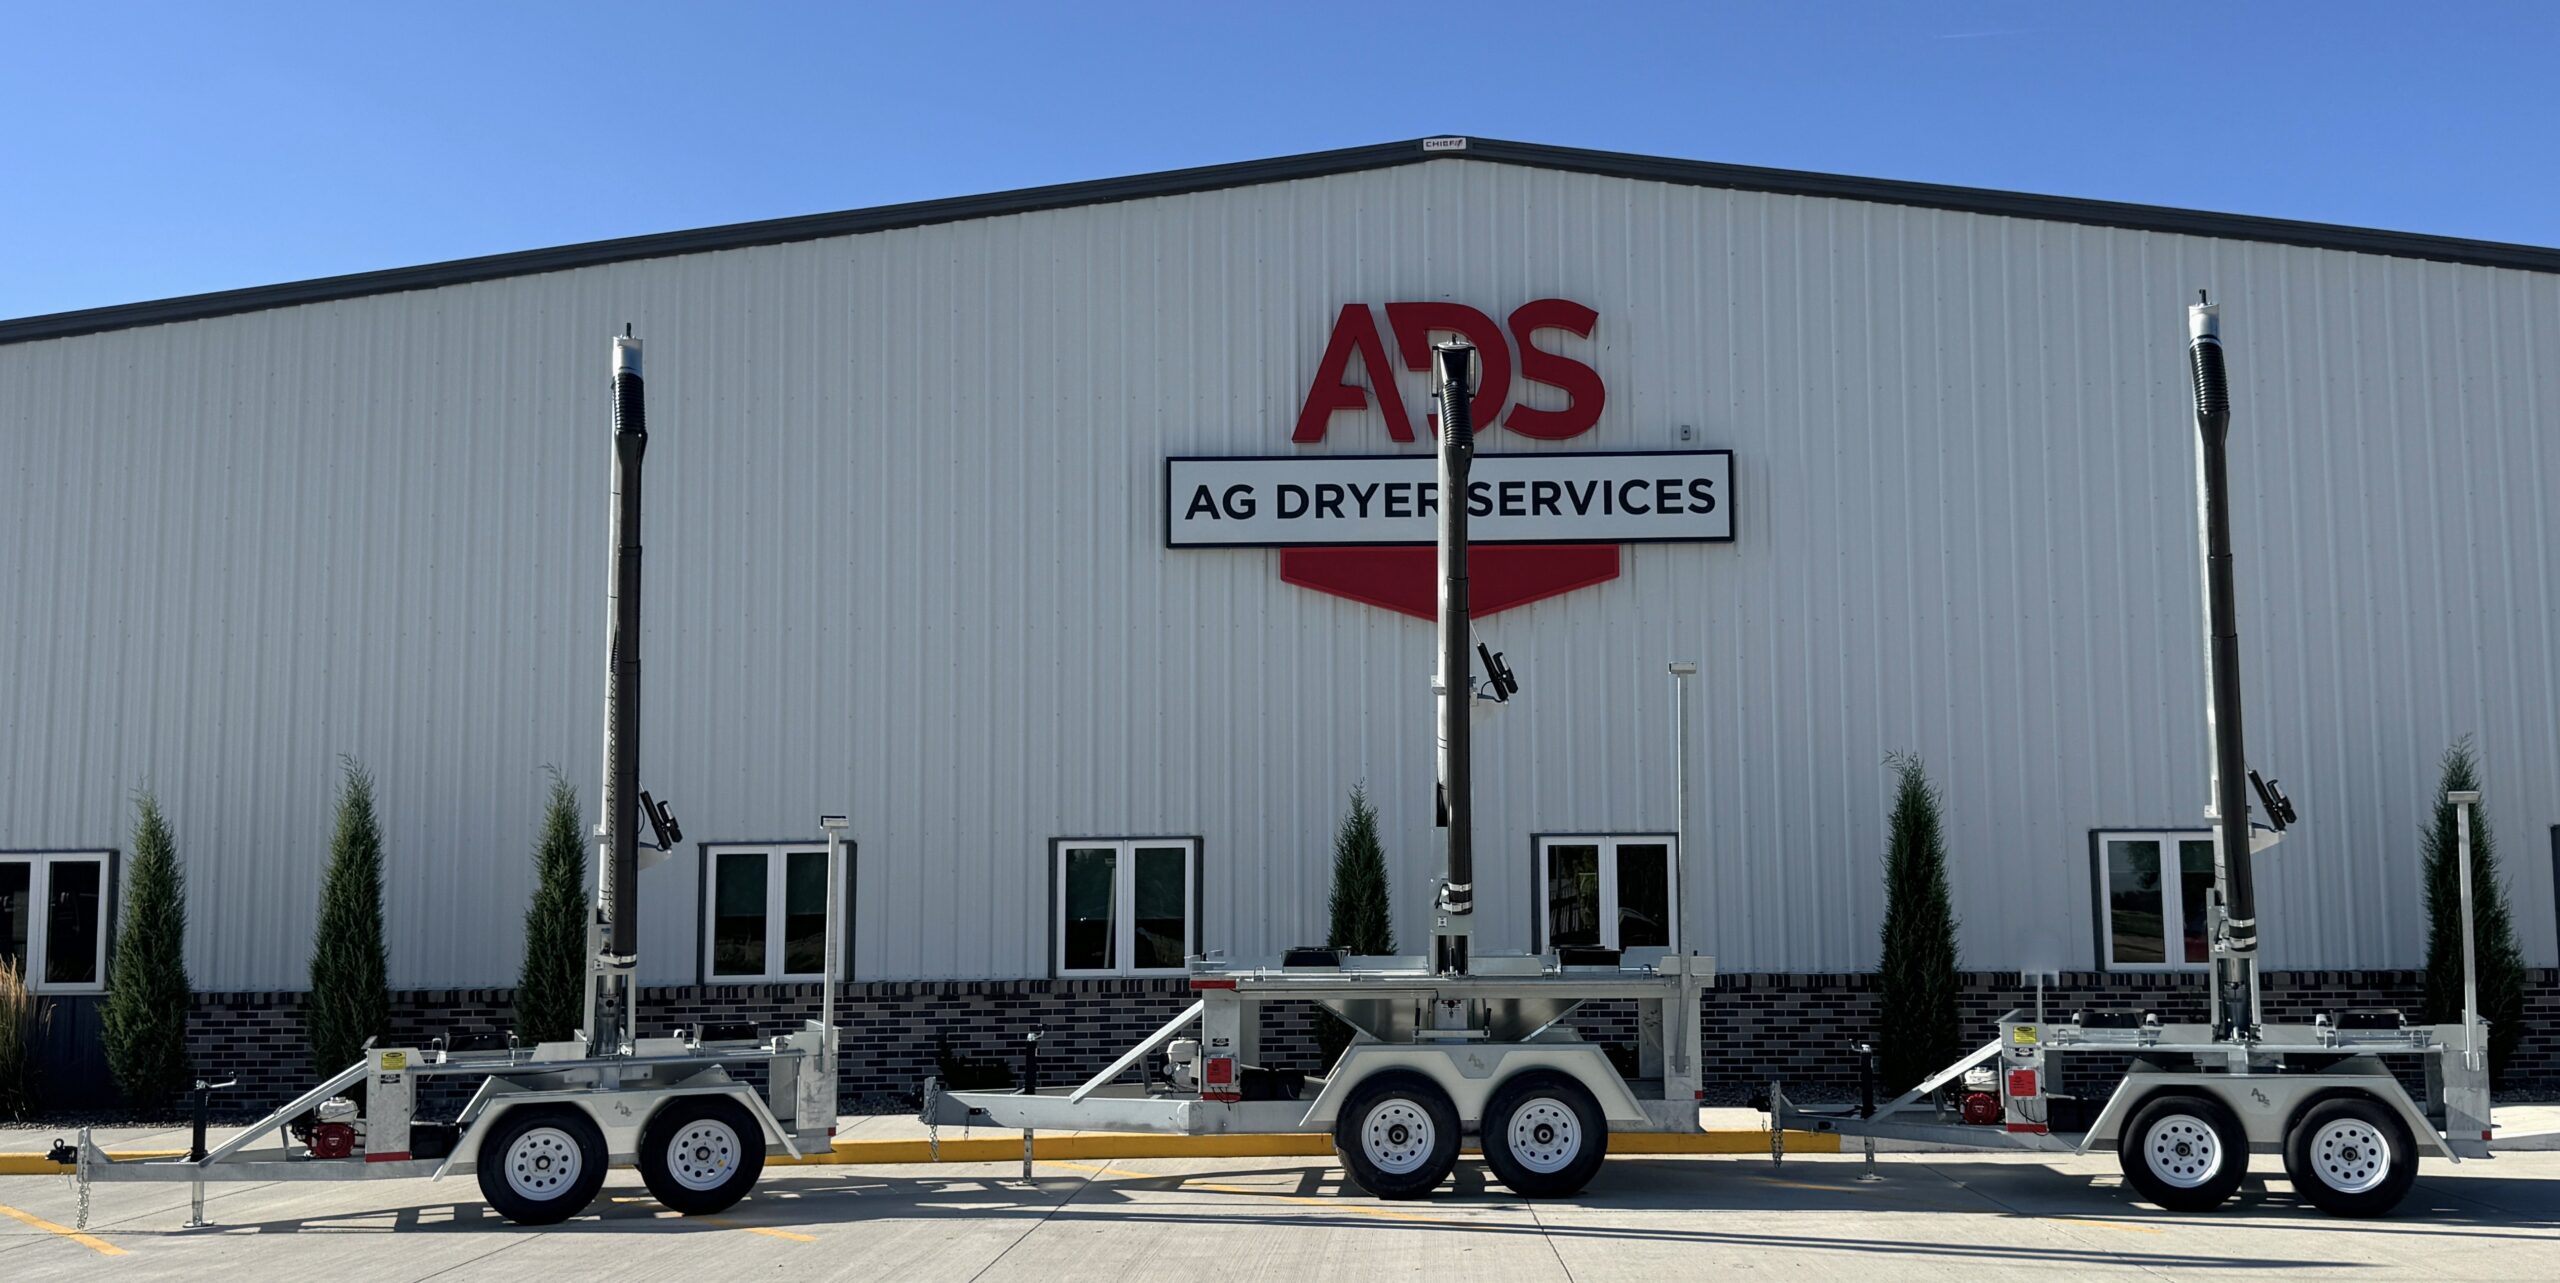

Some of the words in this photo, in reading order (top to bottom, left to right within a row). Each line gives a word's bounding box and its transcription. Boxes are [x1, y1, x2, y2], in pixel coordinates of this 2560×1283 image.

[1291, 298, 1606, 443] ADS
[1185, 484, 1256, 520] AG
[1276, 482, 1438, 519] DRYER
[1468, 478, 1716, 517] SERVICES
